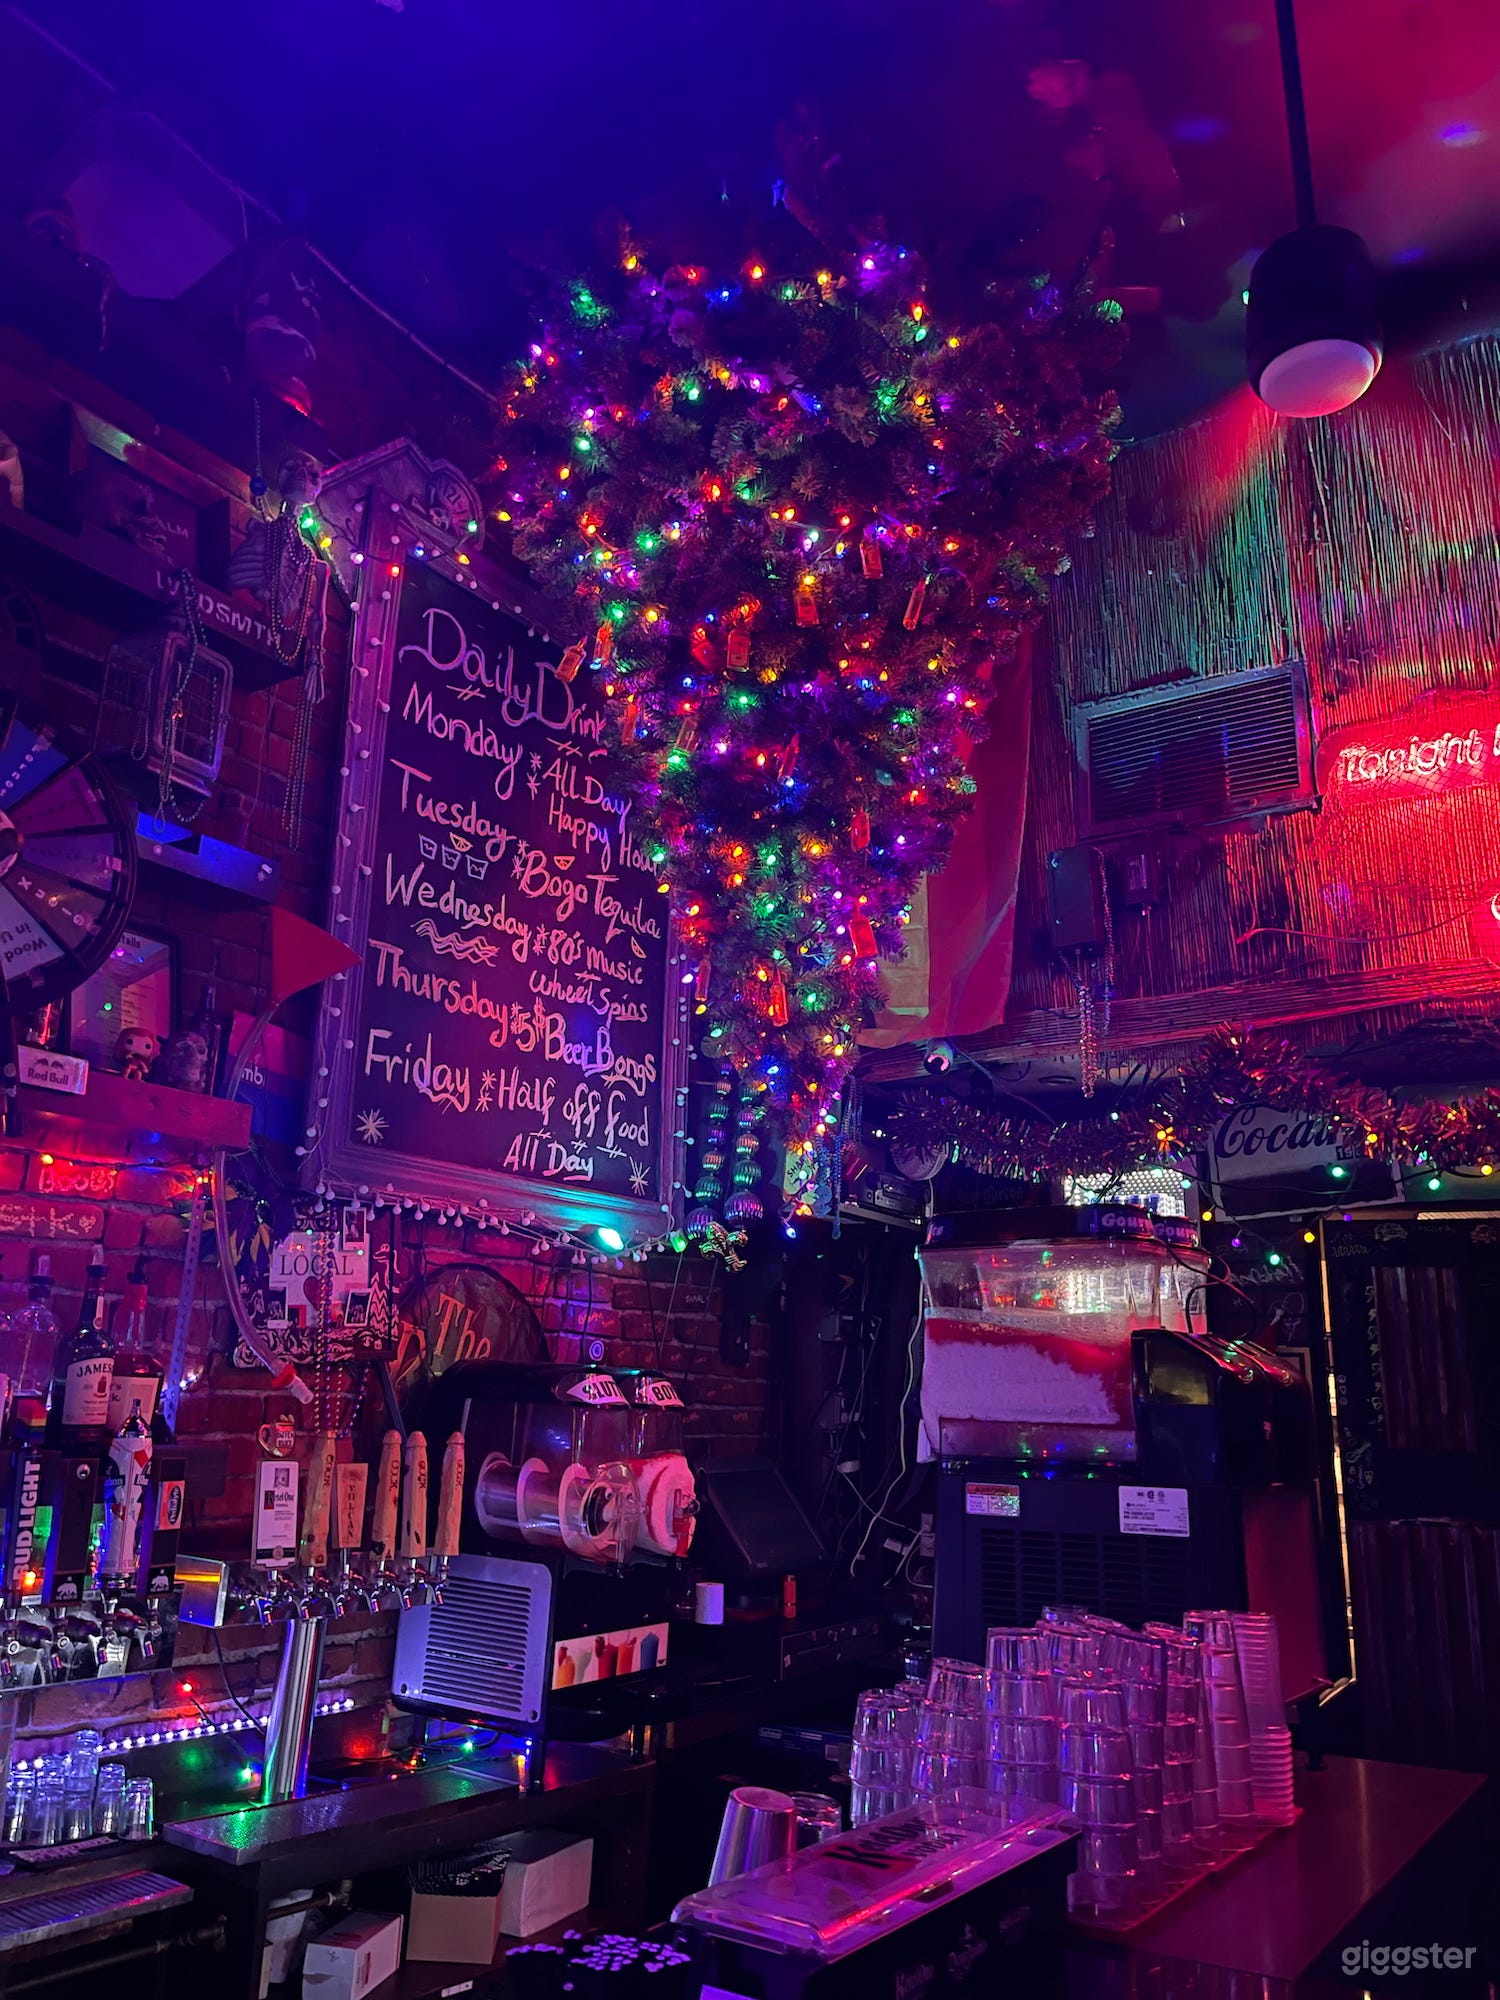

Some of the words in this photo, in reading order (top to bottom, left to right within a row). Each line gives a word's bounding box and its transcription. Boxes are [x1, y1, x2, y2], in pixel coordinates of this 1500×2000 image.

[399, 608, 531, 726] Daily
[403, 682, 522, 800] Monday
[581, 776, 632, 835] Day
[1339, 728, 1485, 782] Tonight
[390, 758, 517, 862] Tuesday
[549, 793, 611, 873] Happy
[385, 853, 532, 962] Wednesday
[368, 939, 510, 1048] Thursday
[545, 1012, 593, 1066] Beer
[28, 1068, 48, 1081] Red
[49, 1073, 69, 1085] Bull
[365, 1029, 471, 1112] Friday
[499, 1067, 556, 1126] Half
[562, 1083, 602, 1138] off
[543, 1142, 594, 1179] Day
[279, 1255, 354, 1277] LOCAL
[19, 1460, 40, 1528] LIGHT
[13, 1530, 34, 1582] BUD
